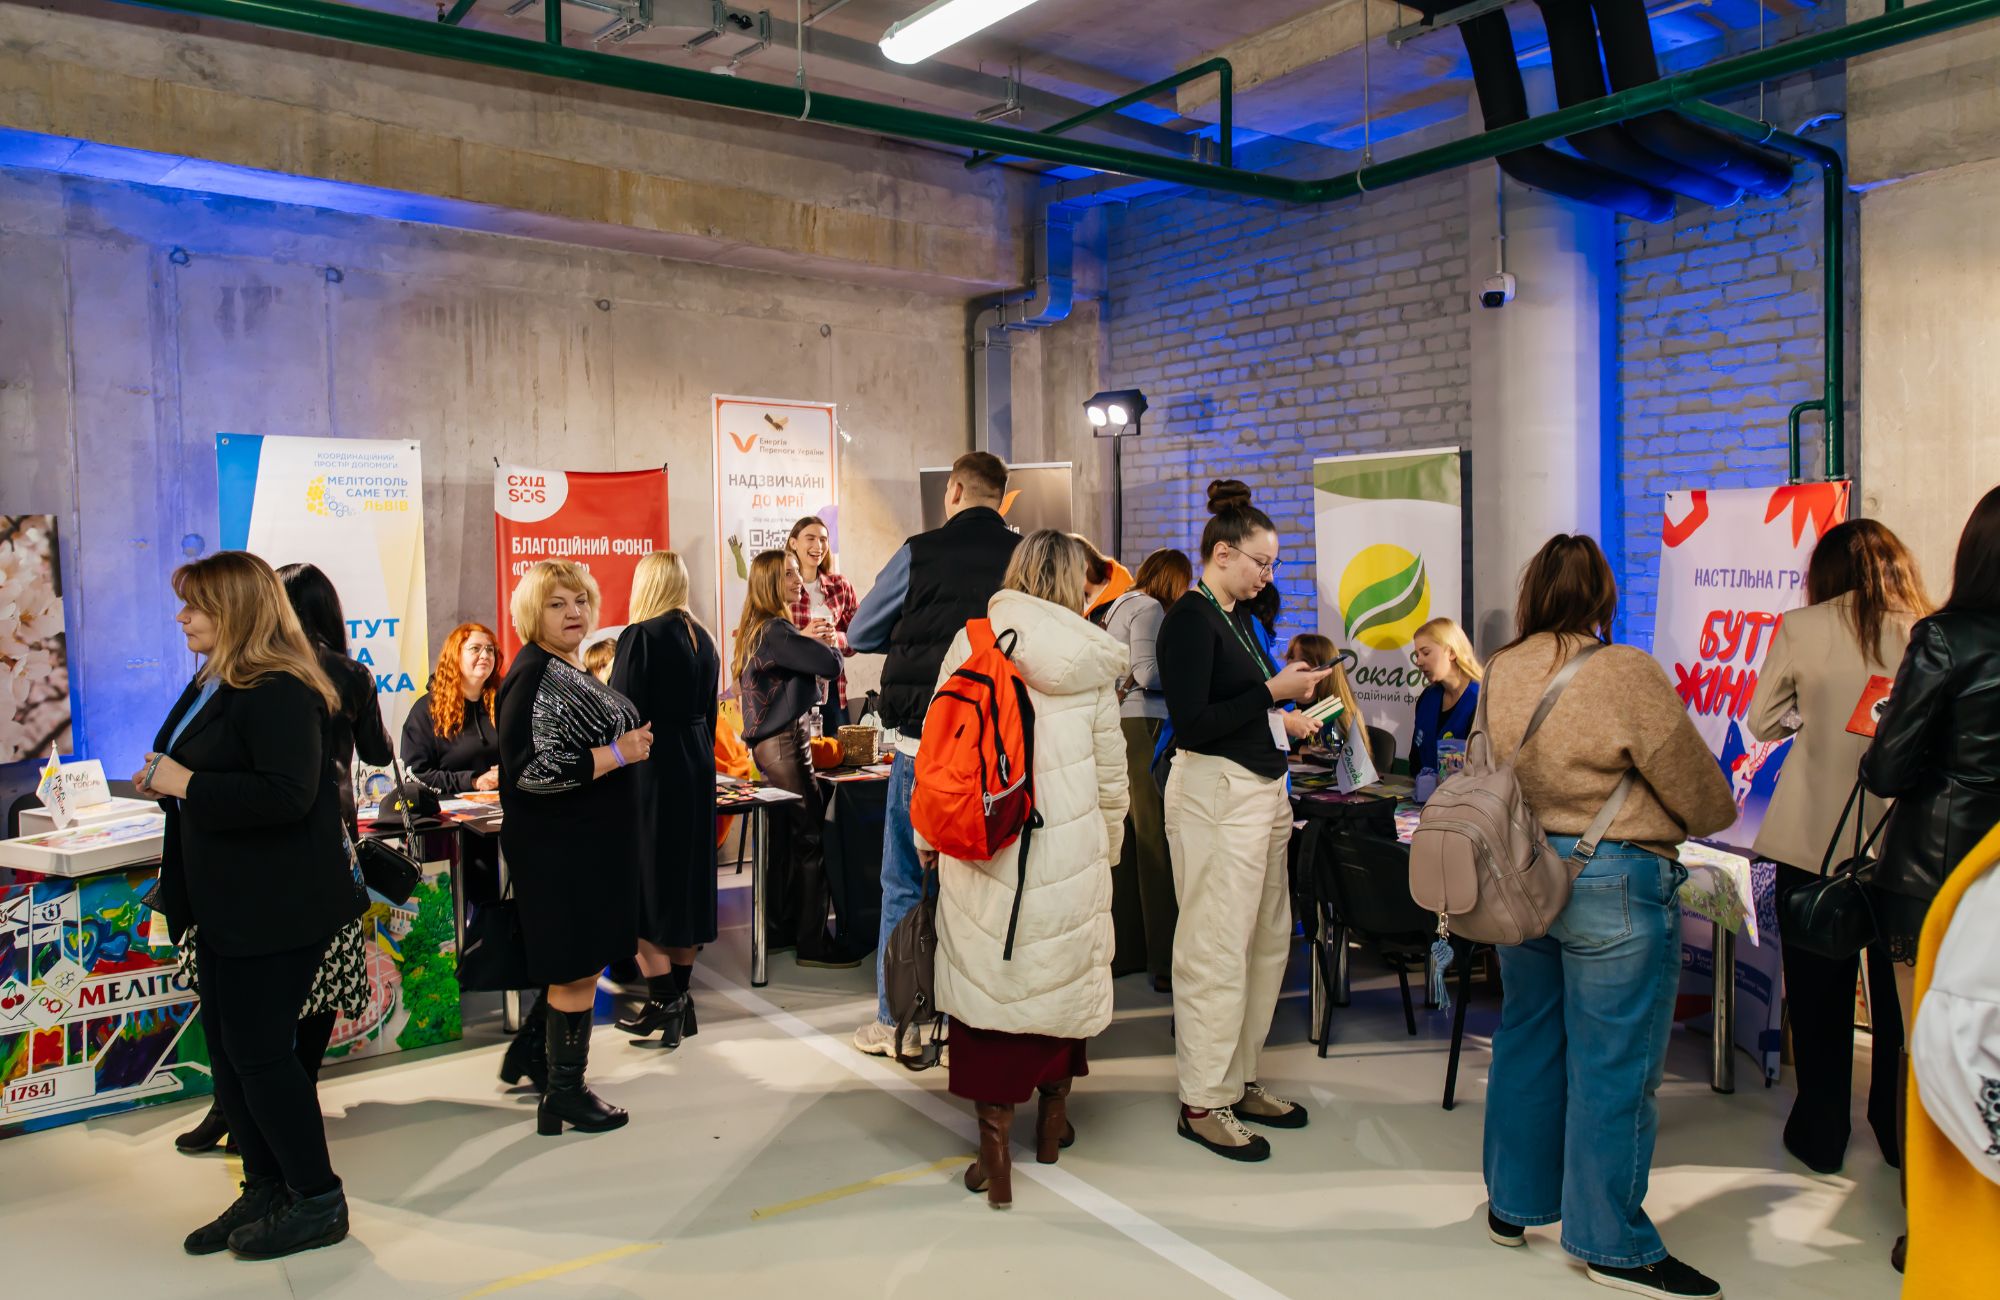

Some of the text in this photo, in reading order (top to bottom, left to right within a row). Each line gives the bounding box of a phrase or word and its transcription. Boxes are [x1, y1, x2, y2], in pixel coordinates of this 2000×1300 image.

[317, 452, 395, 461] КООРДИНАЦІЙНИЙ
[351, 461, 398, 469] ДОПОМОГИ
[327, 476, 408, 487] МЕЛІТОПОЛЬ
[507, 474, 546, 488] СХІД
[728, 473, 825, 489] НАДЗВИЧАЙНІ
[346, 488, 409, 498] САМЕ ТУТ.
[508, 489, 546, 503] SOS
[363, 500, 409, 512] ЛЬВІВ
[752, 493, 804, 509] ДО МРІЇ
[512, 535, 653, 557] БЛАГОДІЙНИЙ ФОНД
[1694, 568, 1774, 589] НАСТІЛЬНА
[345, 618, 400, 639] ТУТ
[10, 1081, 51, 1101] 1784
